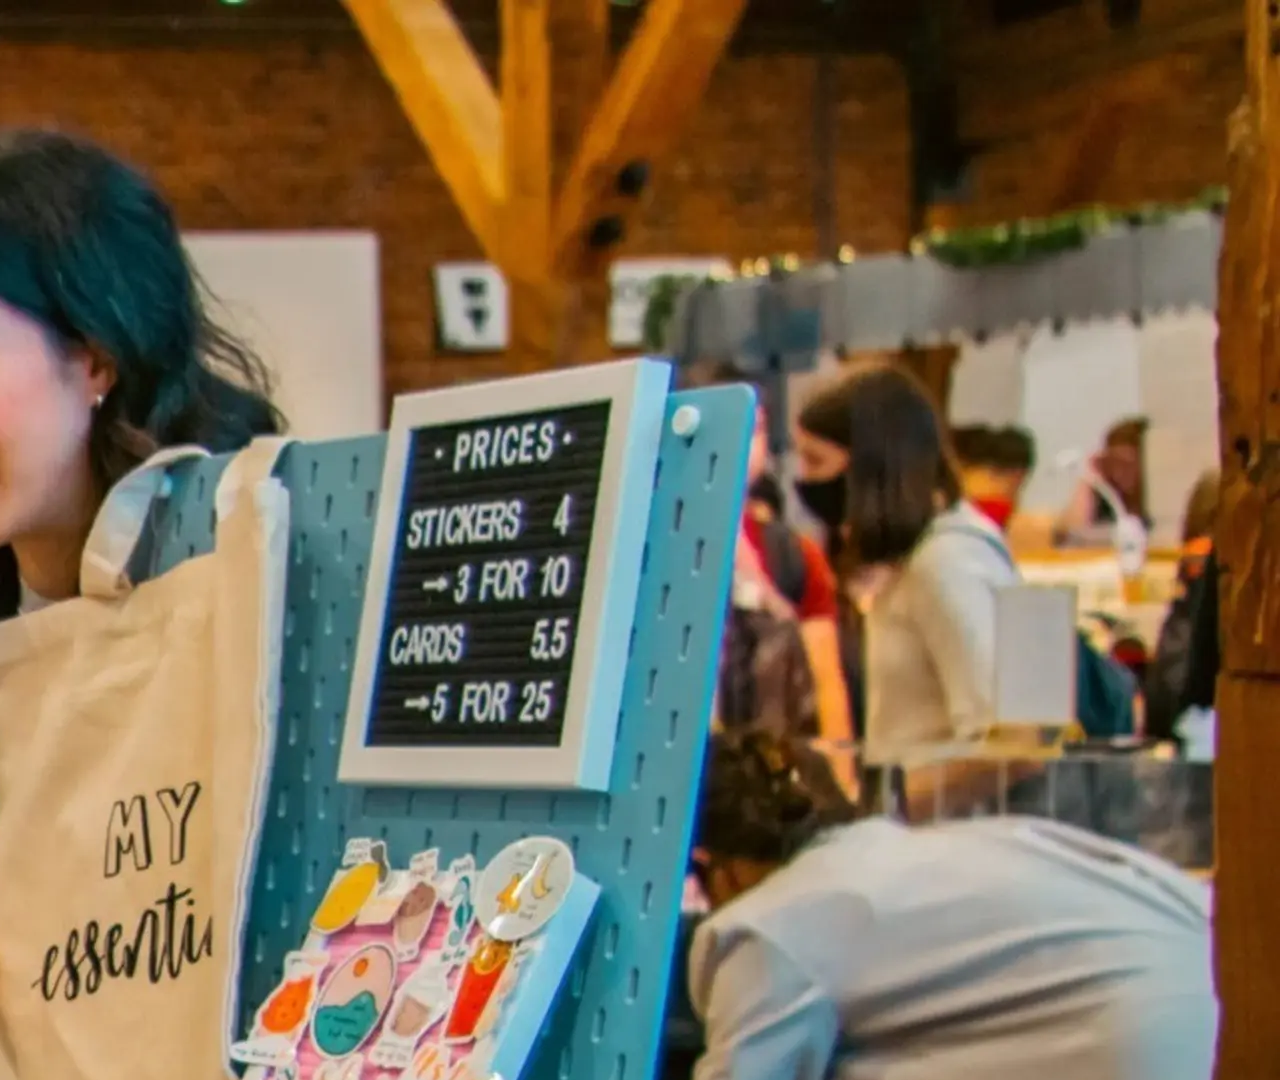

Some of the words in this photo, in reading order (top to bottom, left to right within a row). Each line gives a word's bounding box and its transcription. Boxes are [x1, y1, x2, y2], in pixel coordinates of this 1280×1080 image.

[453, 421, 555, 472] PRICES
[407, 500, 522, 549] STICKERS
[552, 495, 571, 536] 4
[453, 565, 470, 604] 3
[479, 560, 527, 603] FOR
[541, 556, 571, 598] 10
[390, 624, 465, 665] CARDS
[430, 684, 448, 724] 5
[459, 682, 510, 723] FOR
[519, 682, 553, 722] 25
[103, 781, 201, 878] MY
[31, 882, 213, 1002] essenti
